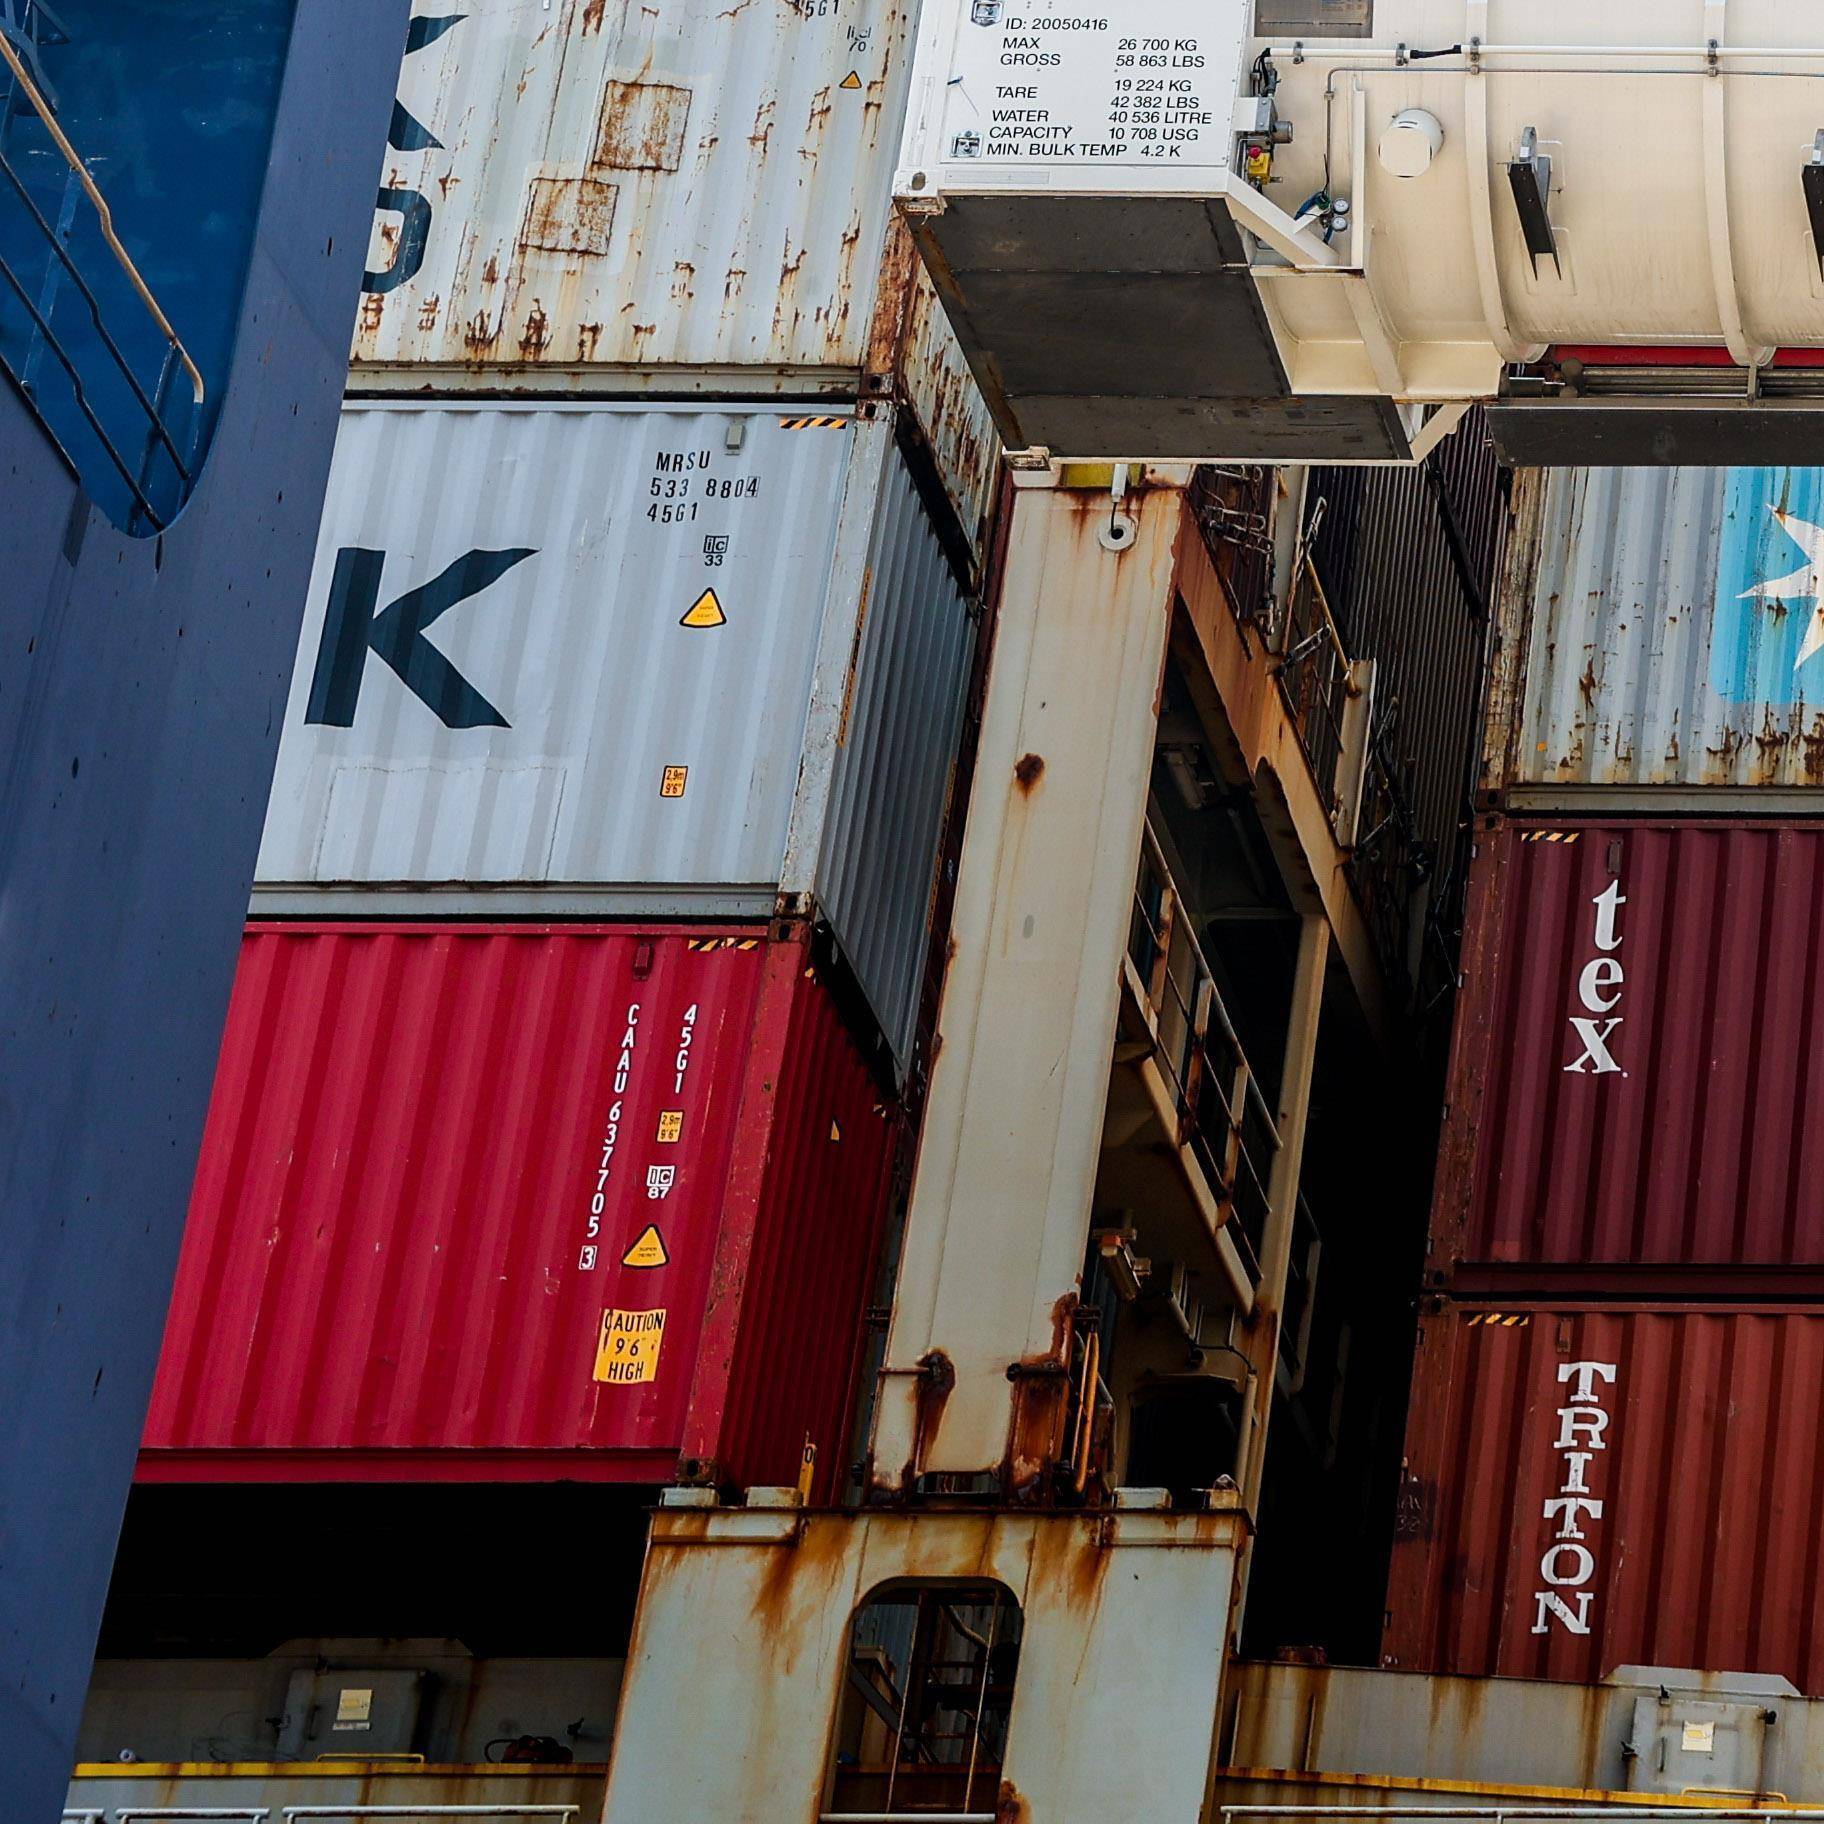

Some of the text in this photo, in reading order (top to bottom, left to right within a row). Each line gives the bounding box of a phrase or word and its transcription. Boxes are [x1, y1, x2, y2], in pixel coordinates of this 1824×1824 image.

[1031, 18, 1108, 31] 20050416
[1002, 37, 1041, 49] MAX
[1117, 39, 1198, 52] 26 700 KG
[1000, 53, 1061, 66] GROSS
[1115, 54, 1205, 69] 58 863 LBS
[996, 86, 1038, 99] TARE
[1115, 79, 1192, 93] 19 224 KG
[1110, 95, 1200, 110] 42 382 LBS
[992, 109, 1049, 122] WATER
[1108, 111, 1212, 125] 40 536 LITRE
[989, 126, 1072, 139] CAPACITY
[1108, 127, 1199, 141] 10 708 USG
[987, 143, 1182, 157] MIN. BULK TEMP 4.2 K
[656, 450, 711, 472] MRSU
[650, 477, 758, 499] 533 8804
[647, 502, 698, 523] 45G1
[704, 554, 723, 566] 33
[614, 1004, 640, 1094] CAAU
[675, 1004, 697, 1094] 45G1
[587, 1101, 622, 1238] 637705
[647, 1187, 670, 1199] 87
[605, 1311, 664, 1333] CAUTION
[608, 1361, 644, 1381] HIGH
[1532, 1361, 1617, 1635] TRITON
